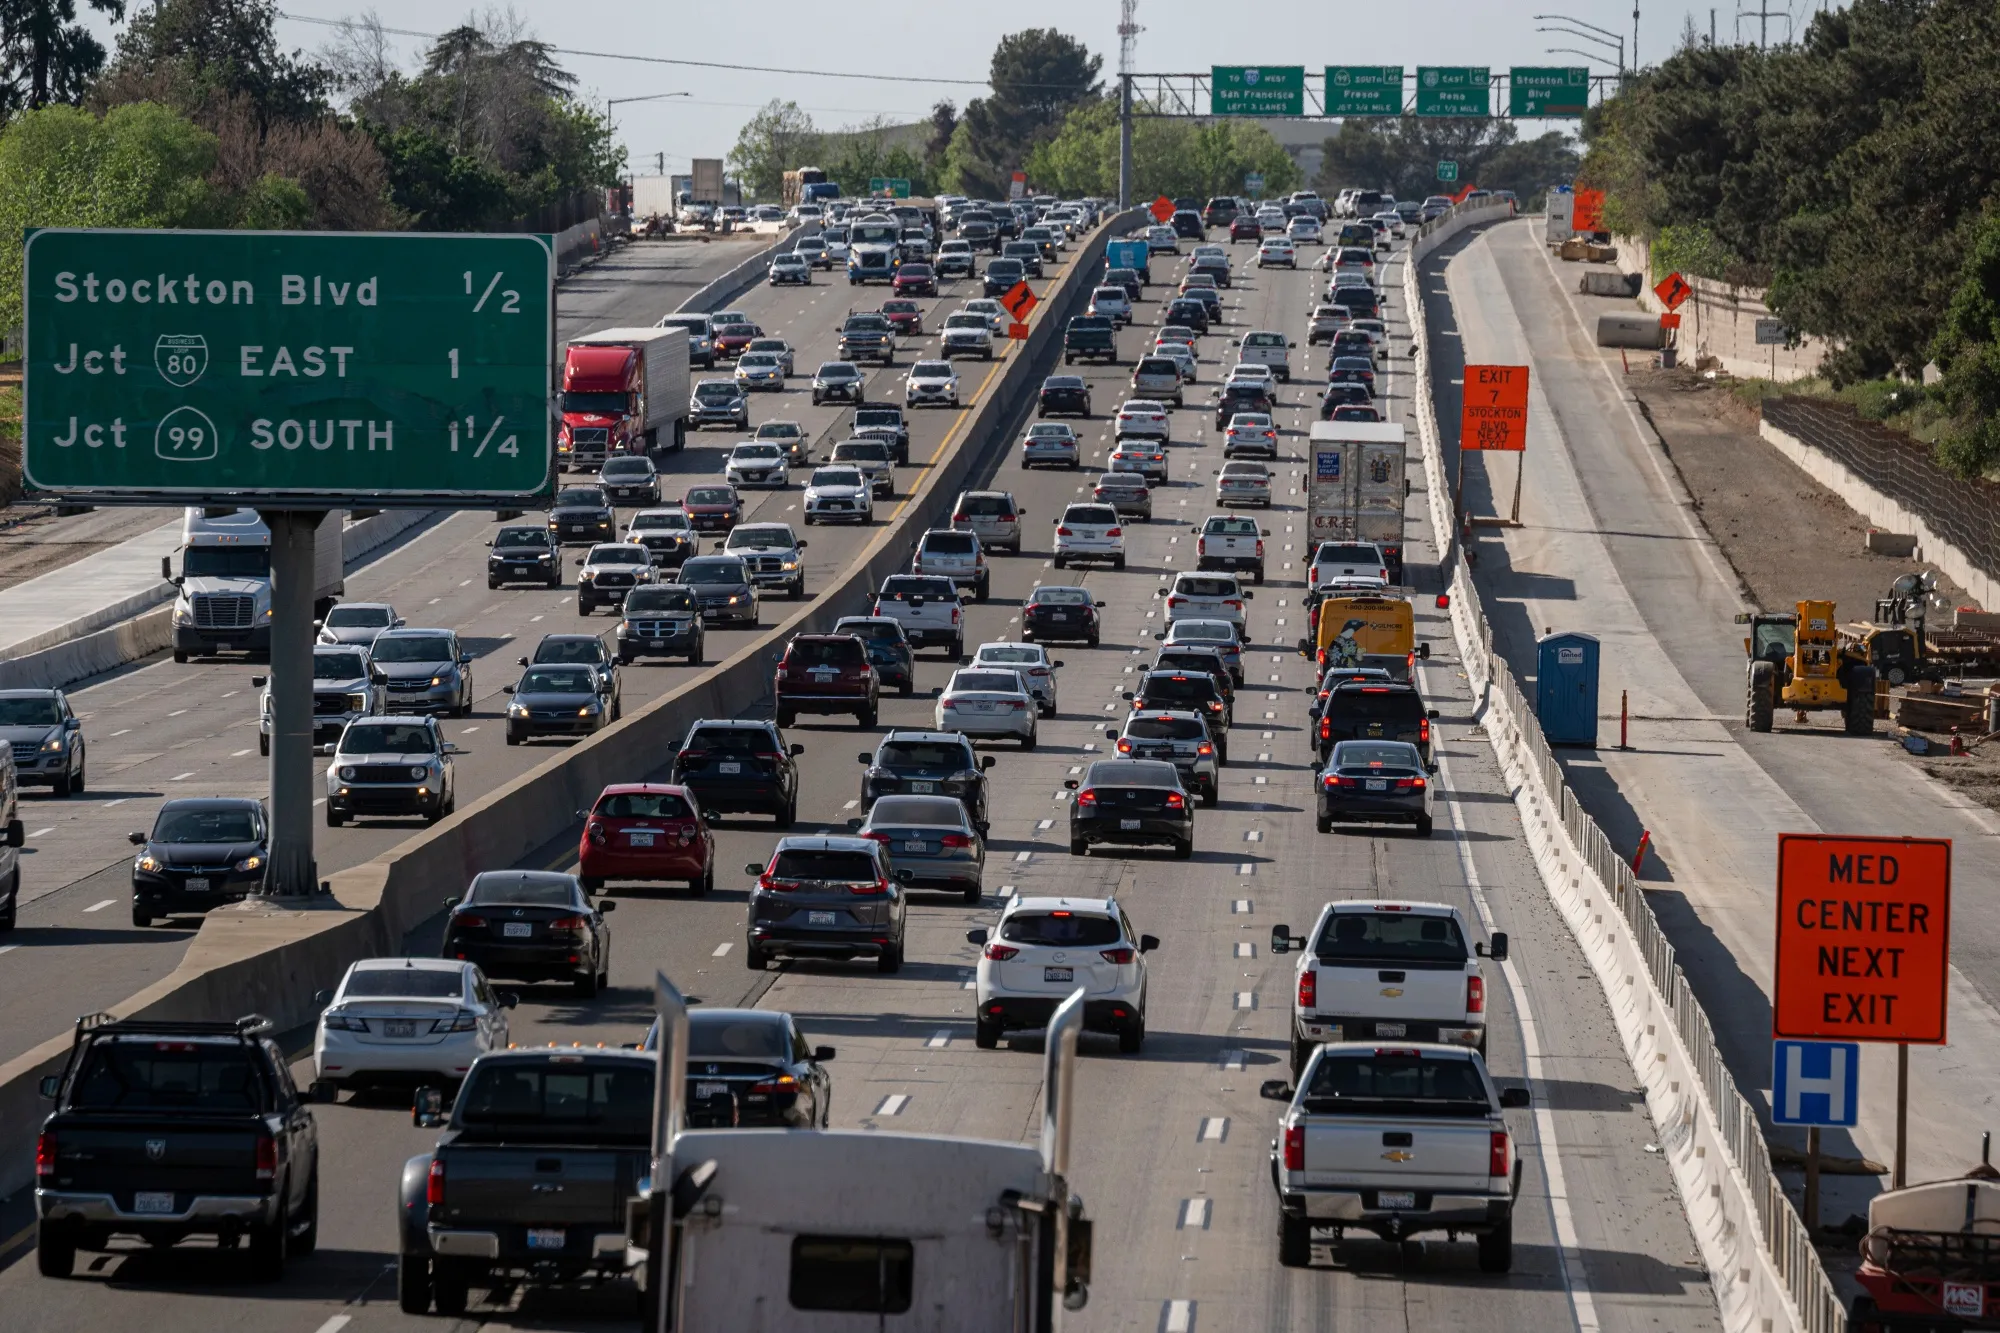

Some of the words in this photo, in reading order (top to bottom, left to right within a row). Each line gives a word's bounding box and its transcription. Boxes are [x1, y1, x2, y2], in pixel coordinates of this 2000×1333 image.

[1442, 75, 1464, 83] EAST
[1516, 75, 1563, 84] Stockton
[1220, 90, 1240, 98] San
[1243, 90, 1294, 99] Francisco
[1344, 90, 1379, 99] Fresno
[1439, 92, 1465, 100] Reno
[1528, 89, 1551, 98] Blvd
[1227, 103, 1246, 111] LEFT
[1259, 103, 1287, 111] LANES
[55, 271, 254, 304] Stockton
[281, 275, 377, 306] Blvd
[463, 270, 521, 313] 1/2
[53, 343, 127, 375] Jct
[167, 355, 197, 375] 80
[240, 346, 354, 377] EAST
[447, 348, 459, 379] 1
[1480, 369, 1512, 384] EXIT
[1489, 390, 1499, 403] 7
[1469, 408, 1520, 418] STOCKTON
[1481, 421, 1507, 431] BLVD
[53, 416, 127, 448] Jct
[168, 428, 204, 450] 99
[250, 420, 393, 451] SOUTH
[1477, 430, 1510, 440] NEXT
[1480, 440, 1506, 449] EXIT
[1561, 650, 1582, 658] United
[1829, 854, 1899, 885] MED
[1797, 899, 1929, 934] CENTER
[1818, 946, 1904, 978] NEXT
[1823, 993, 1898, 1024] EXIT
[1785, 1045, 1846, 1121] H
